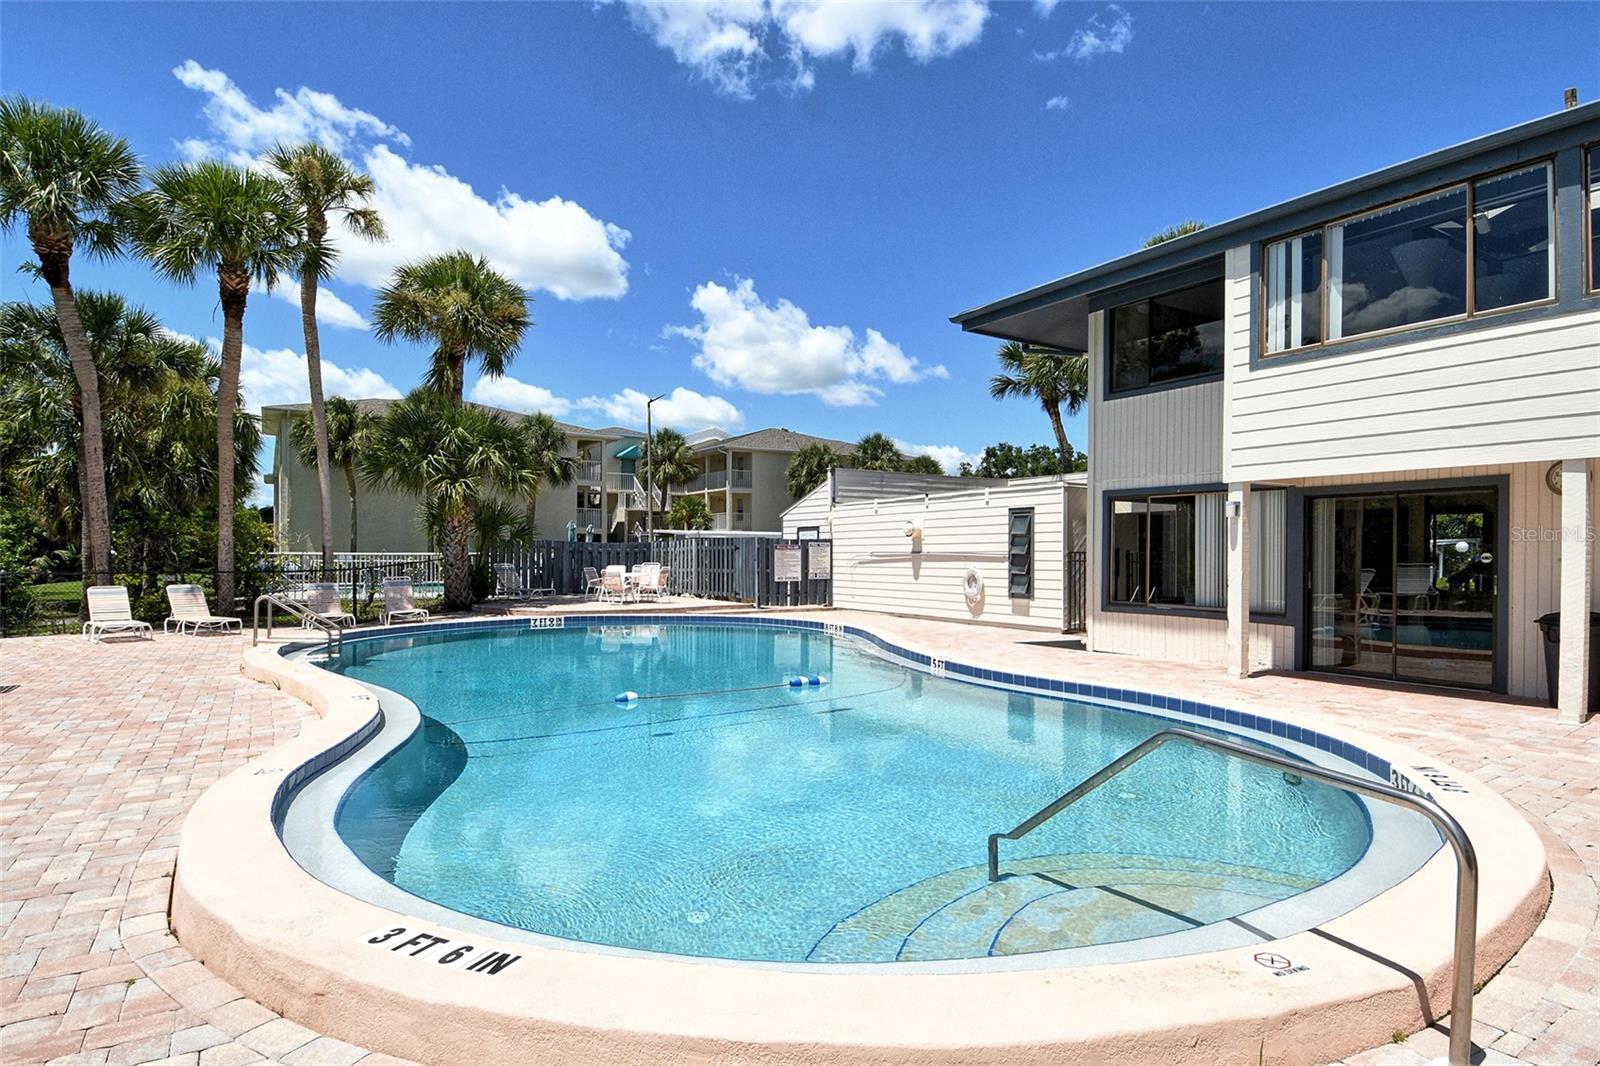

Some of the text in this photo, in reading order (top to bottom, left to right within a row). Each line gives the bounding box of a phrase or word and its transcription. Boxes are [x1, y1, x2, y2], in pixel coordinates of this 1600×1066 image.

[932, 658, 944, 669] 5 FT
[1391, 769, 1400, 789] 3
[368, 927, 523, 976] 3 FT 6 IN
